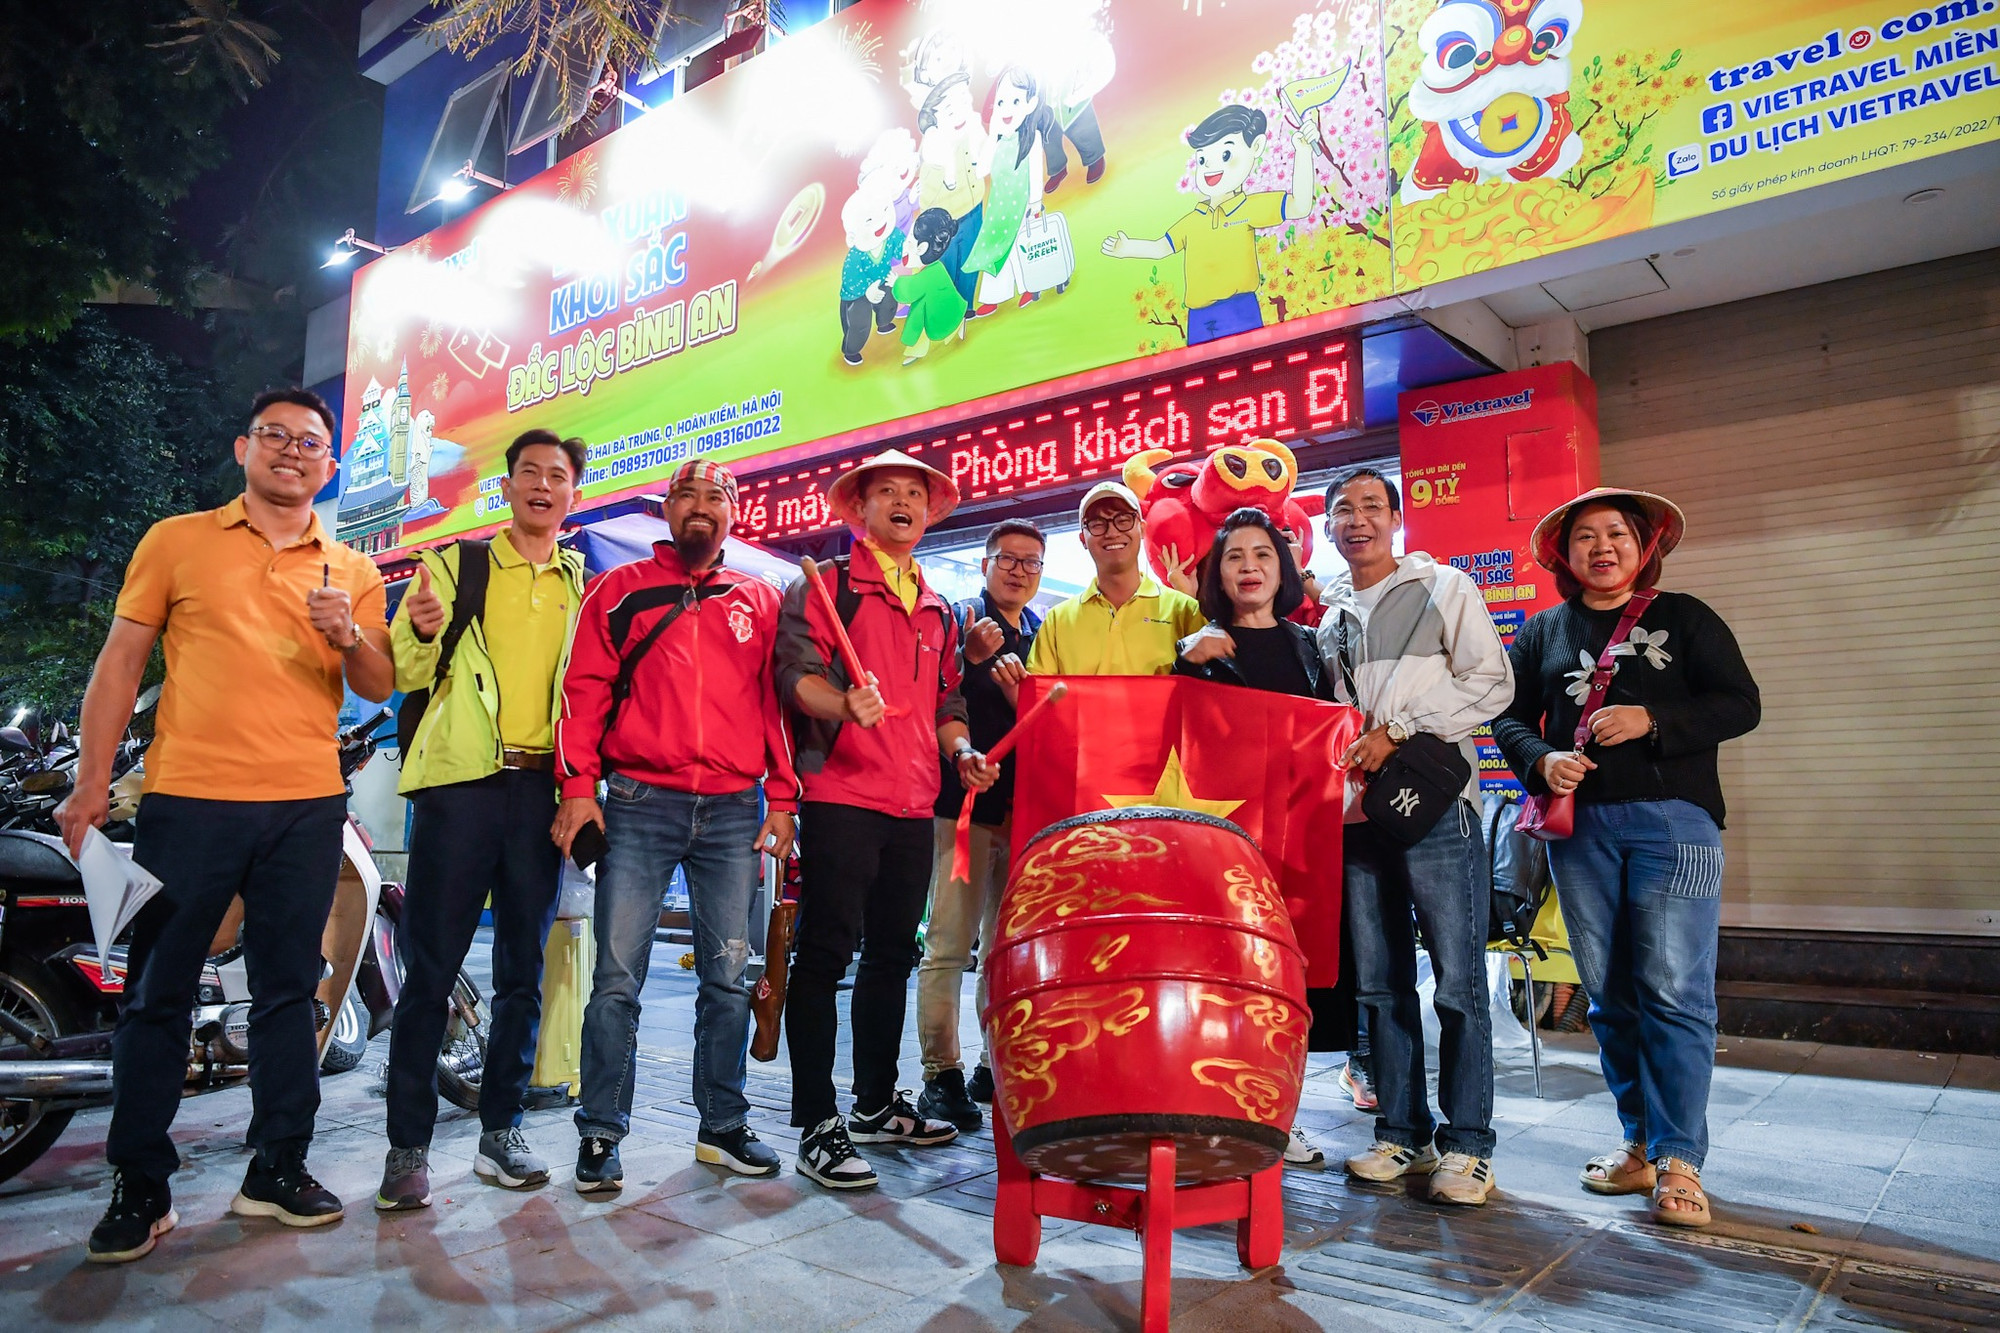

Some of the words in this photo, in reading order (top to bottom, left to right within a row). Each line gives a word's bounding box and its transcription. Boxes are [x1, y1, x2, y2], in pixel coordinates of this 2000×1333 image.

[1708, 32, 1842, 92] travel
[1743, 57, 1906, 119] VIETRAVEL
[1915, 28, 1999, 71] MIỀN
[1710, 135, 1748, 163] DU
[1756, 115, 1819, 151] LỊCH
[1827, 66, 2000, 129] VIETRAVEL
[1676, 154, 1697, 165] Zalo
[1711, 188, 1727, 200] Số
[1729, 182, 1754, 197] giấy
[1756, 174, 1788, 190] phép
[1790, 165, 1815, 180] kinh
[1818, 154, 1858, 172] doanh
[1861, 143, 1899, 162] LHQT:
[626, 229, 685, 300] SẮC
[1027, 245, 1058, 261] GREEN
[508, 345, 558, 408] ĐẮC
[562, 331, 615, 391] LỘC
[618, 303, 684, 368] BÌNH
[689, 283, 734, 342] AN
[595, 443, 611, 459] HAI
[613, 437, 625, 453] BÀ
[628, 428, 663, 449] TRƯNG,
[677, 414, 707, 435] HOÀN
[709, 404, 739, 425] KIẾM,
[742, 396, 758, 416] HÀ
[761, 390, 781, 411] NỘI
[1441, 389, 1531, 418] Vietravel
[611, 441, 687, 477] 0989370033
[696, 415, 781, 454] 0983160022
[951, 439, 1058, 488] Phòng
[1074, 401, 1190, 465] khách
[1208, 390, 1286, 443] sạn
[776, 482, 832, 527] máy
[1410, 479, 1433, 509] 9
[1434, 472, 1460, 497] TỶ
[1450, 555, 1469, 569] DU
[1473, 549, 1512, 568] XUÂN
[1486, 564, 1514, 583] SẮC
[1484, 586, 1514, 602] BÌNH
[1516, 584, 1536, 600] AN
[59, 896, 89, 904] HON
